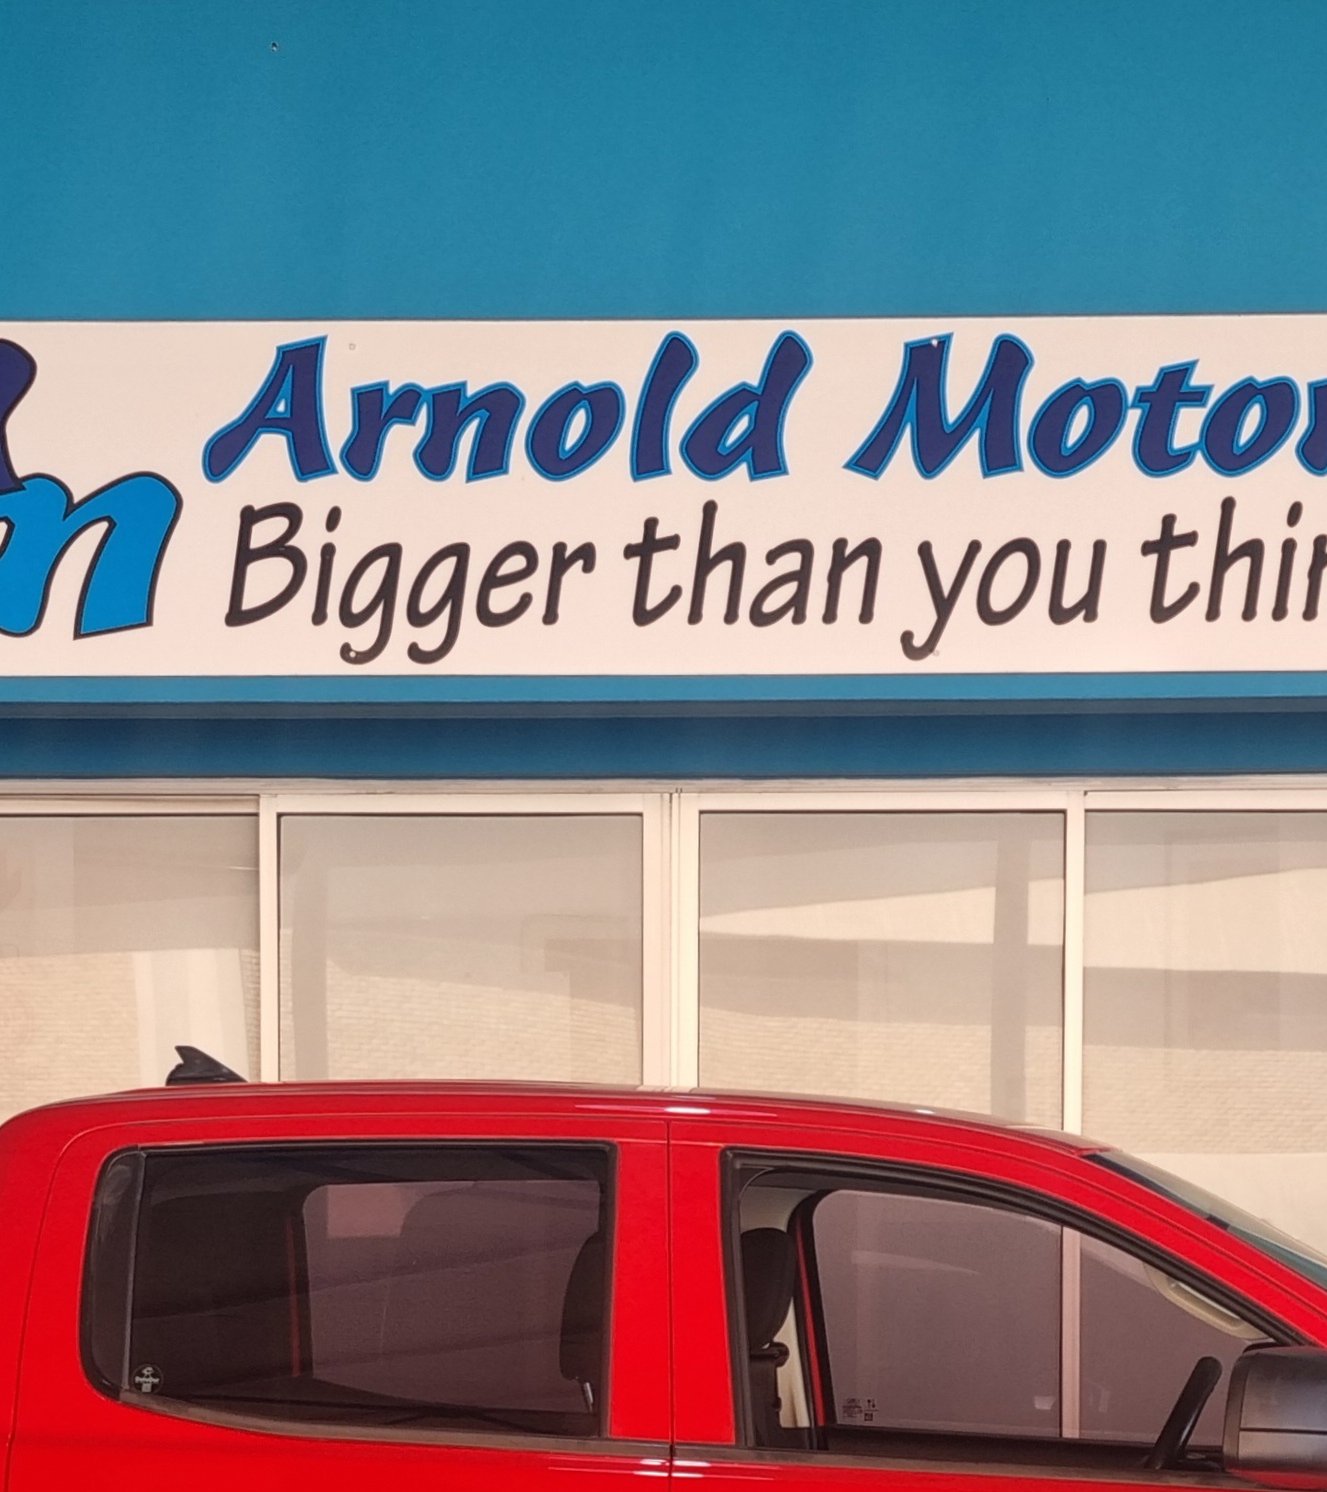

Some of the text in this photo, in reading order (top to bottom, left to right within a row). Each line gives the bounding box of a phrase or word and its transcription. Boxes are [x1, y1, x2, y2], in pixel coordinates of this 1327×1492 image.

[202, 331, 812, 483] Arnold
[225, 502, 596, 664] Bigger
[623, 499, 880, 627] than
[900, 538, 1107, 661] you
